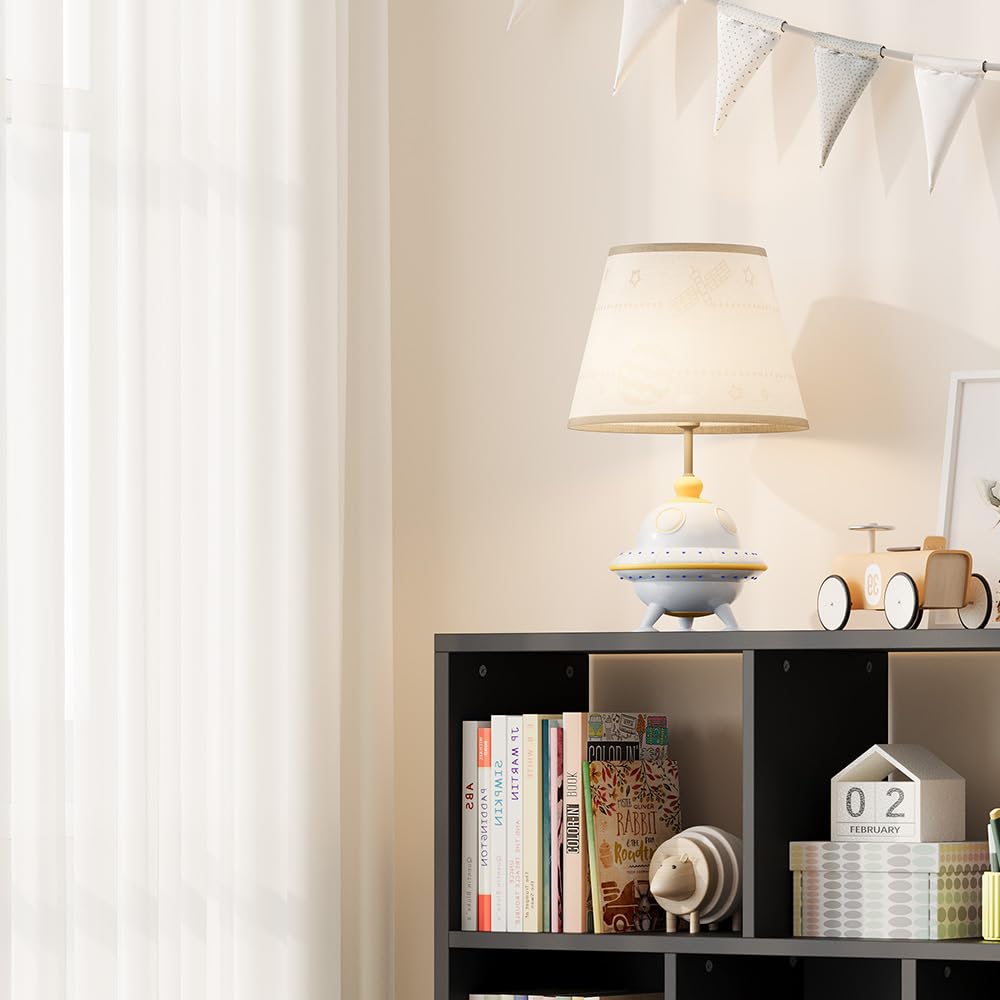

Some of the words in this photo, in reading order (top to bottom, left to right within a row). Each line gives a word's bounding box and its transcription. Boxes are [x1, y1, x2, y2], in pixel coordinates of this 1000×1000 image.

[567, 772, 577, 797] BOOK
[616, 810, 657, 836] RABBIT
[850, 825, 900, 834] FEBRUARY
